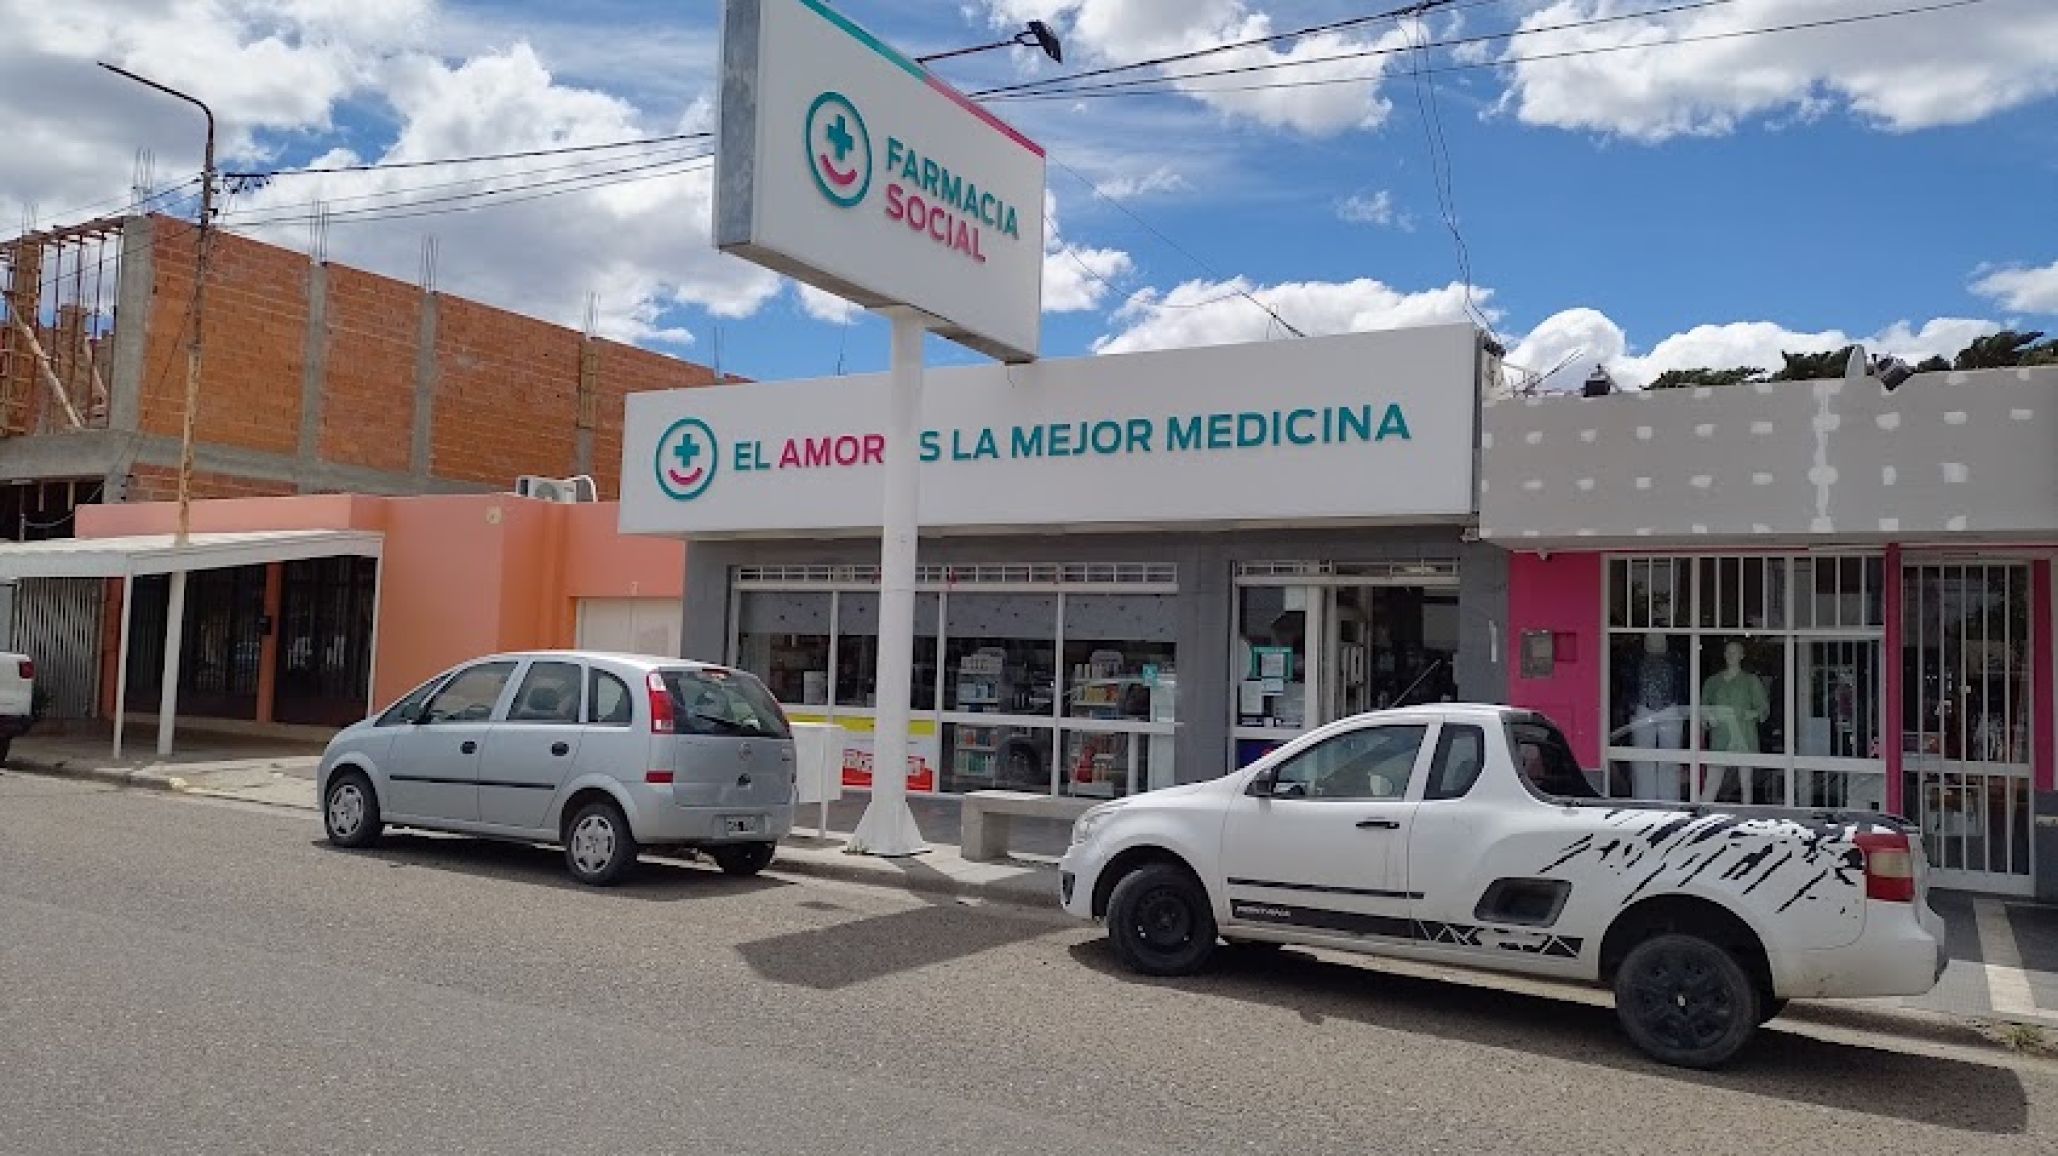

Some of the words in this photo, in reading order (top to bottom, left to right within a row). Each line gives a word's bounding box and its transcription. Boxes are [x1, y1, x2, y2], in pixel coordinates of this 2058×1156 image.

[886, 183, 986, 262] SOCIAL
[887, 136, 1019, 240] FARMACIA
[735, 441, 770, 471] EL
[779, 434, 885, 468] AMOR
[919, 430, 940, 461] S
[952, 428, 1000, 461] LA
[1011, 418, 1153, 458] MEJOR
[1166, 404, 1412, 451] MEDICINA
